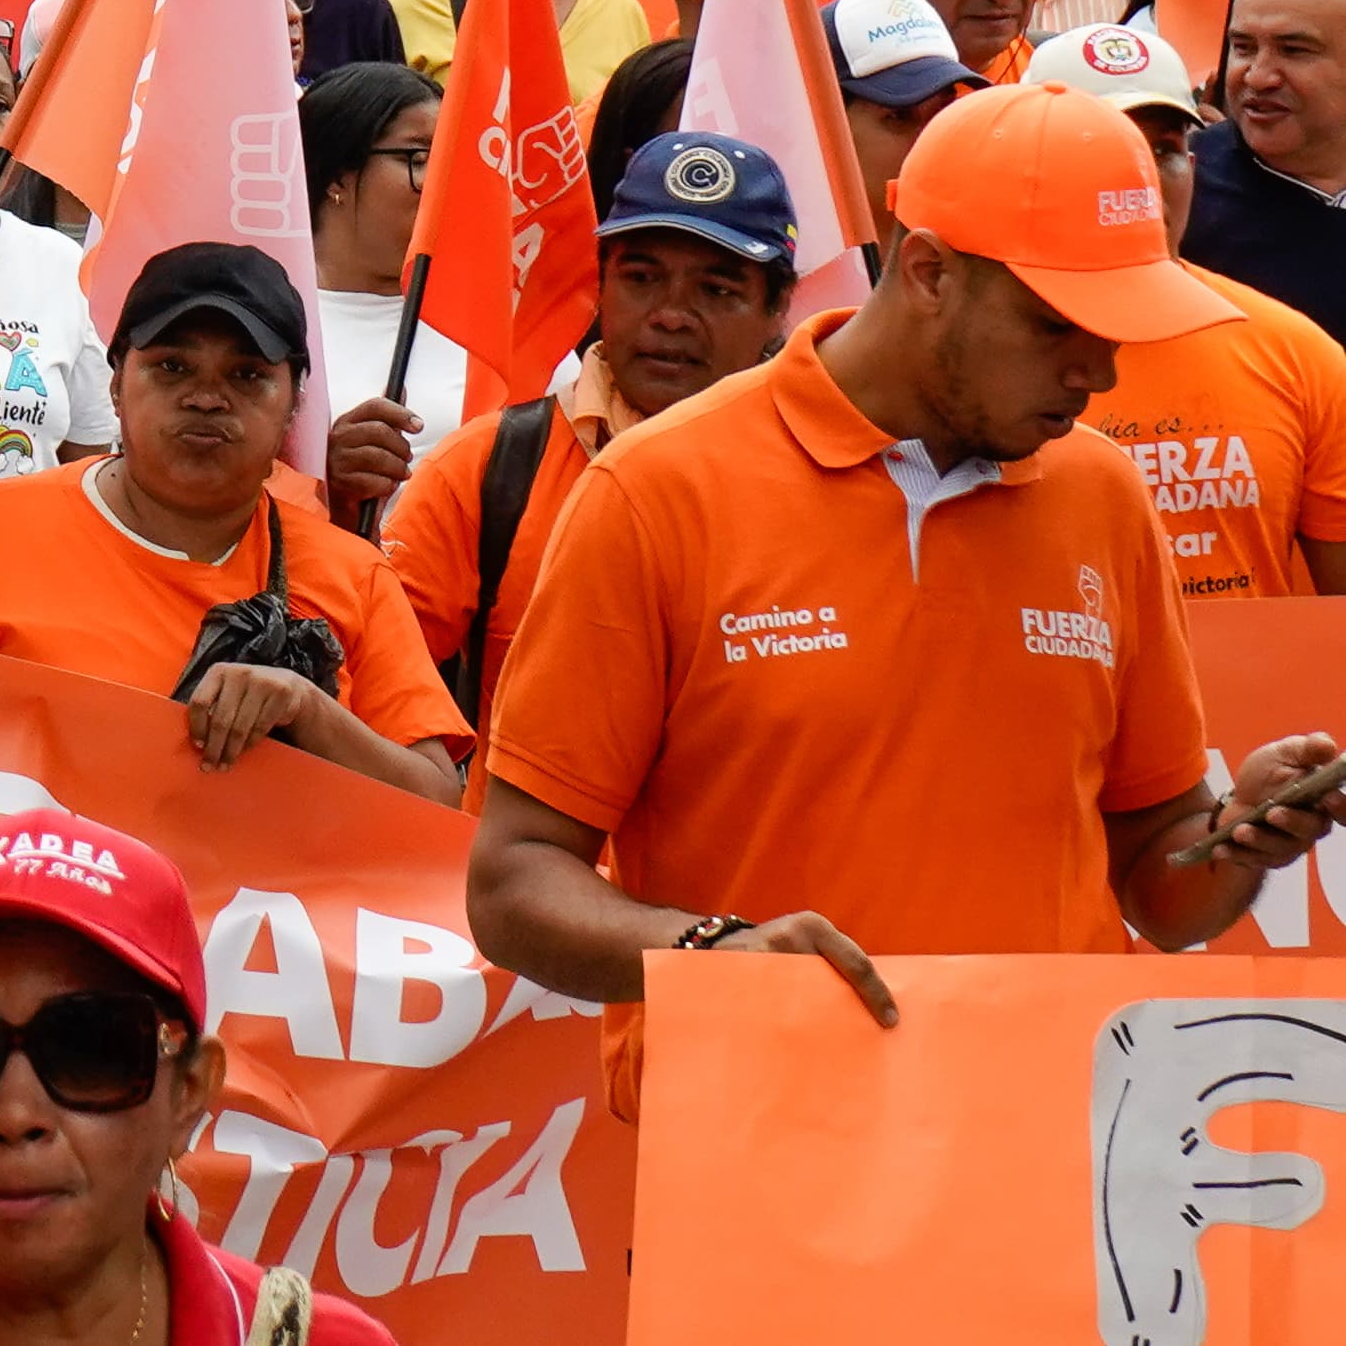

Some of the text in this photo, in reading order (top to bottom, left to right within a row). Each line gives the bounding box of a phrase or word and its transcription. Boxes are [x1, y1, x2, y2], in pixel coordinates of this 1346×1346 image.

[1121, 436, 1257, 486] ERZA
[1154, 479, 1260, 514] ADANA
[720, 605, 837, 636] Camino a
[1021, 607, 1114, 650] FUERZA
[724, 627, 848, 663] la Victoria
